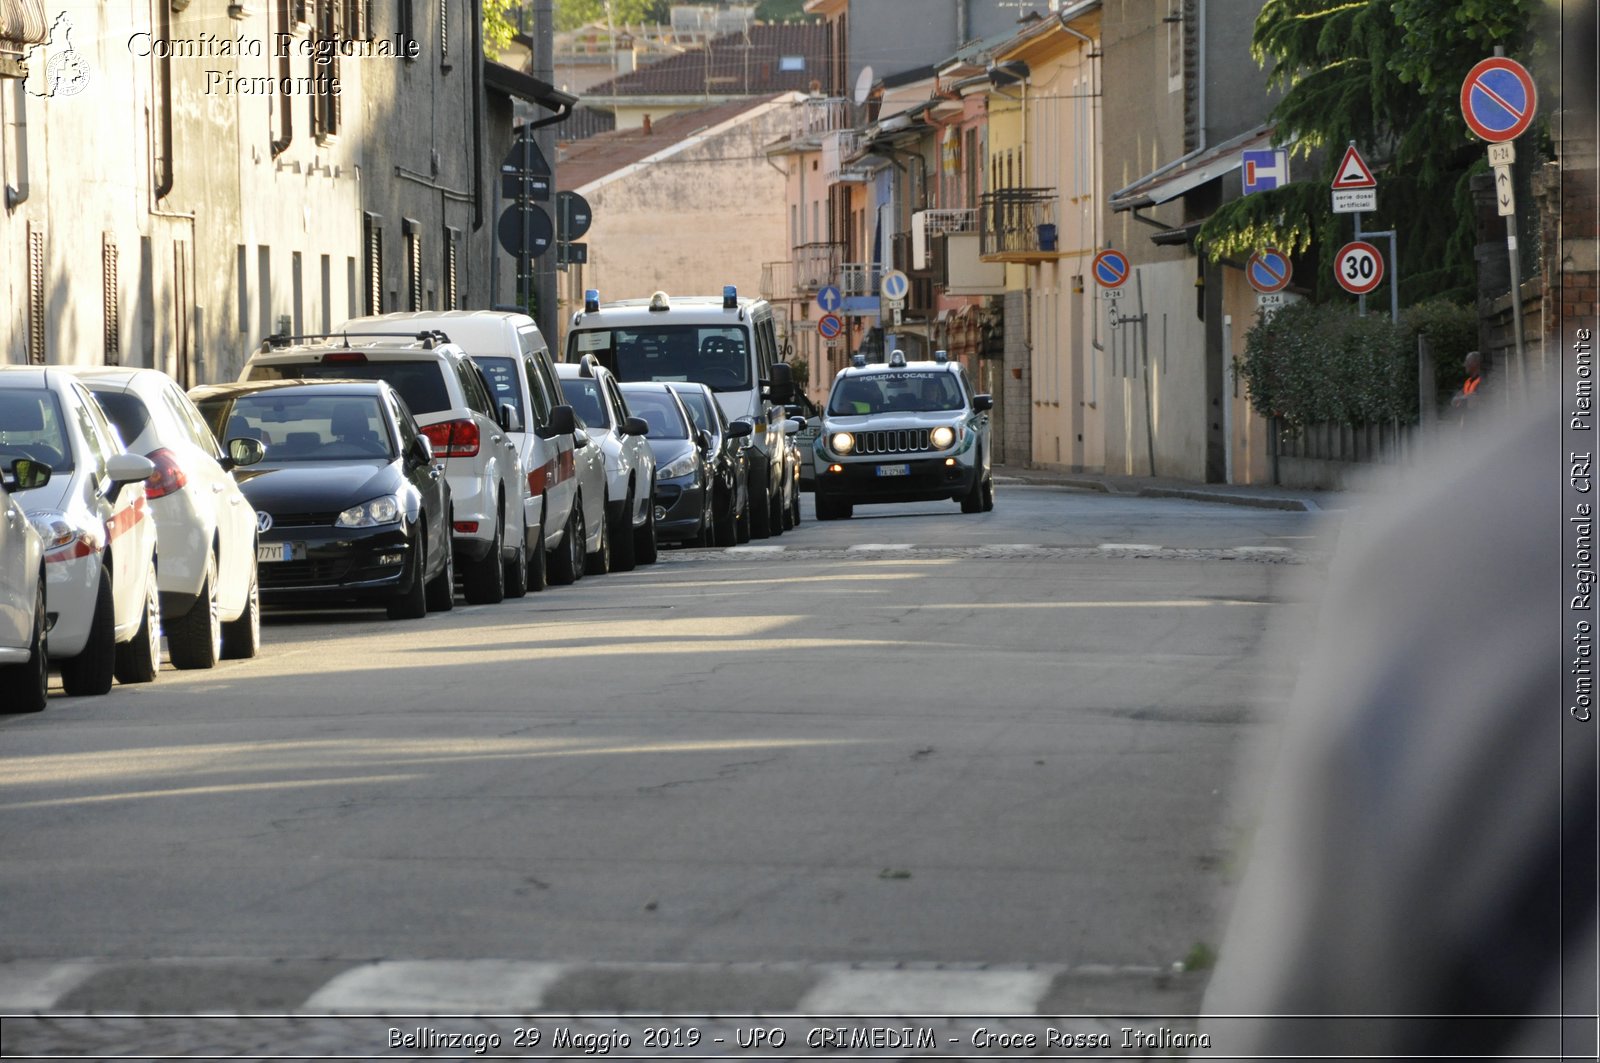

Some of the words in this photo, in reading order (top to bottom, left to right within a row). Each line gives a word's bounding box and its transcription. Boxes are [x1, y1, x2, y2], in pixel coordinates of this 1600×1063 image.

[1493, 147, 1509, 161] 0-24
[1346, 255, 1374, 279] 30
[860, 374, 895, 382] POLIZIA
